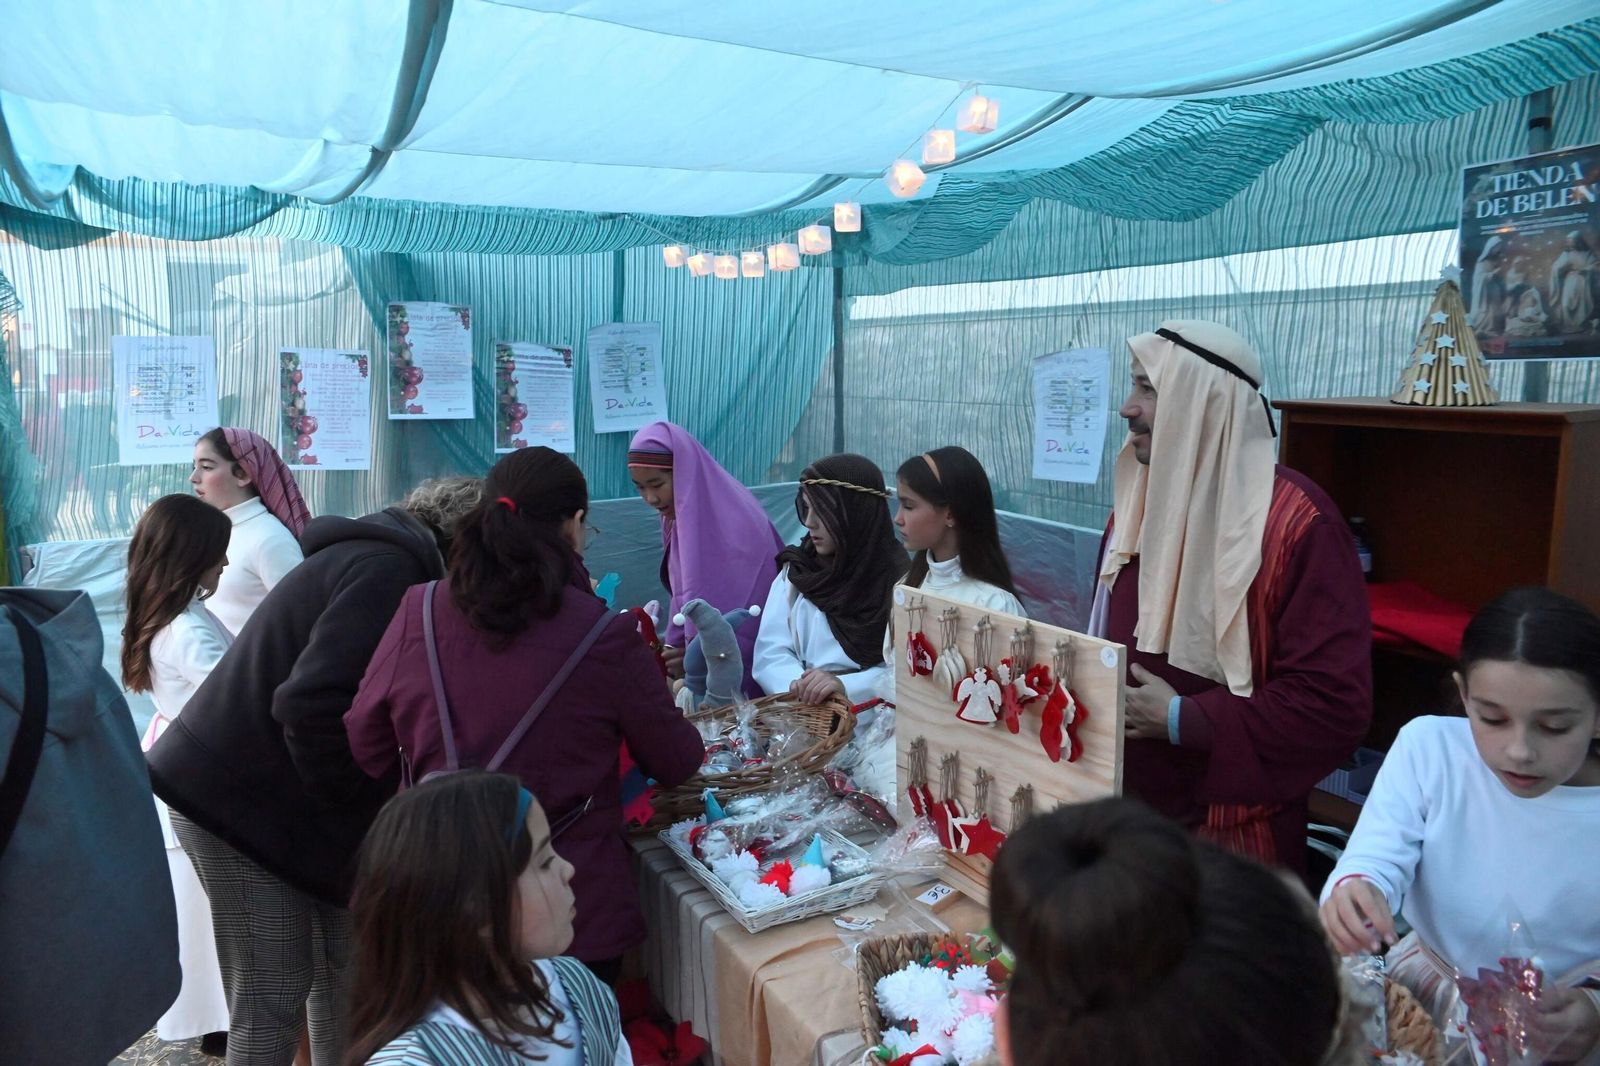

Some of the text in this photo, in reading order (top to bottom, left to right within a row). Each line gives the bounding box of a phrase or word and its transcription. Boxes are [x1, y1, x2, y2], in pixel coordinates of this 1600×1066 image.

[1490, 161, 1584, 194] TIENDA
[1476, 183, 1597, 219] DE BELEN
